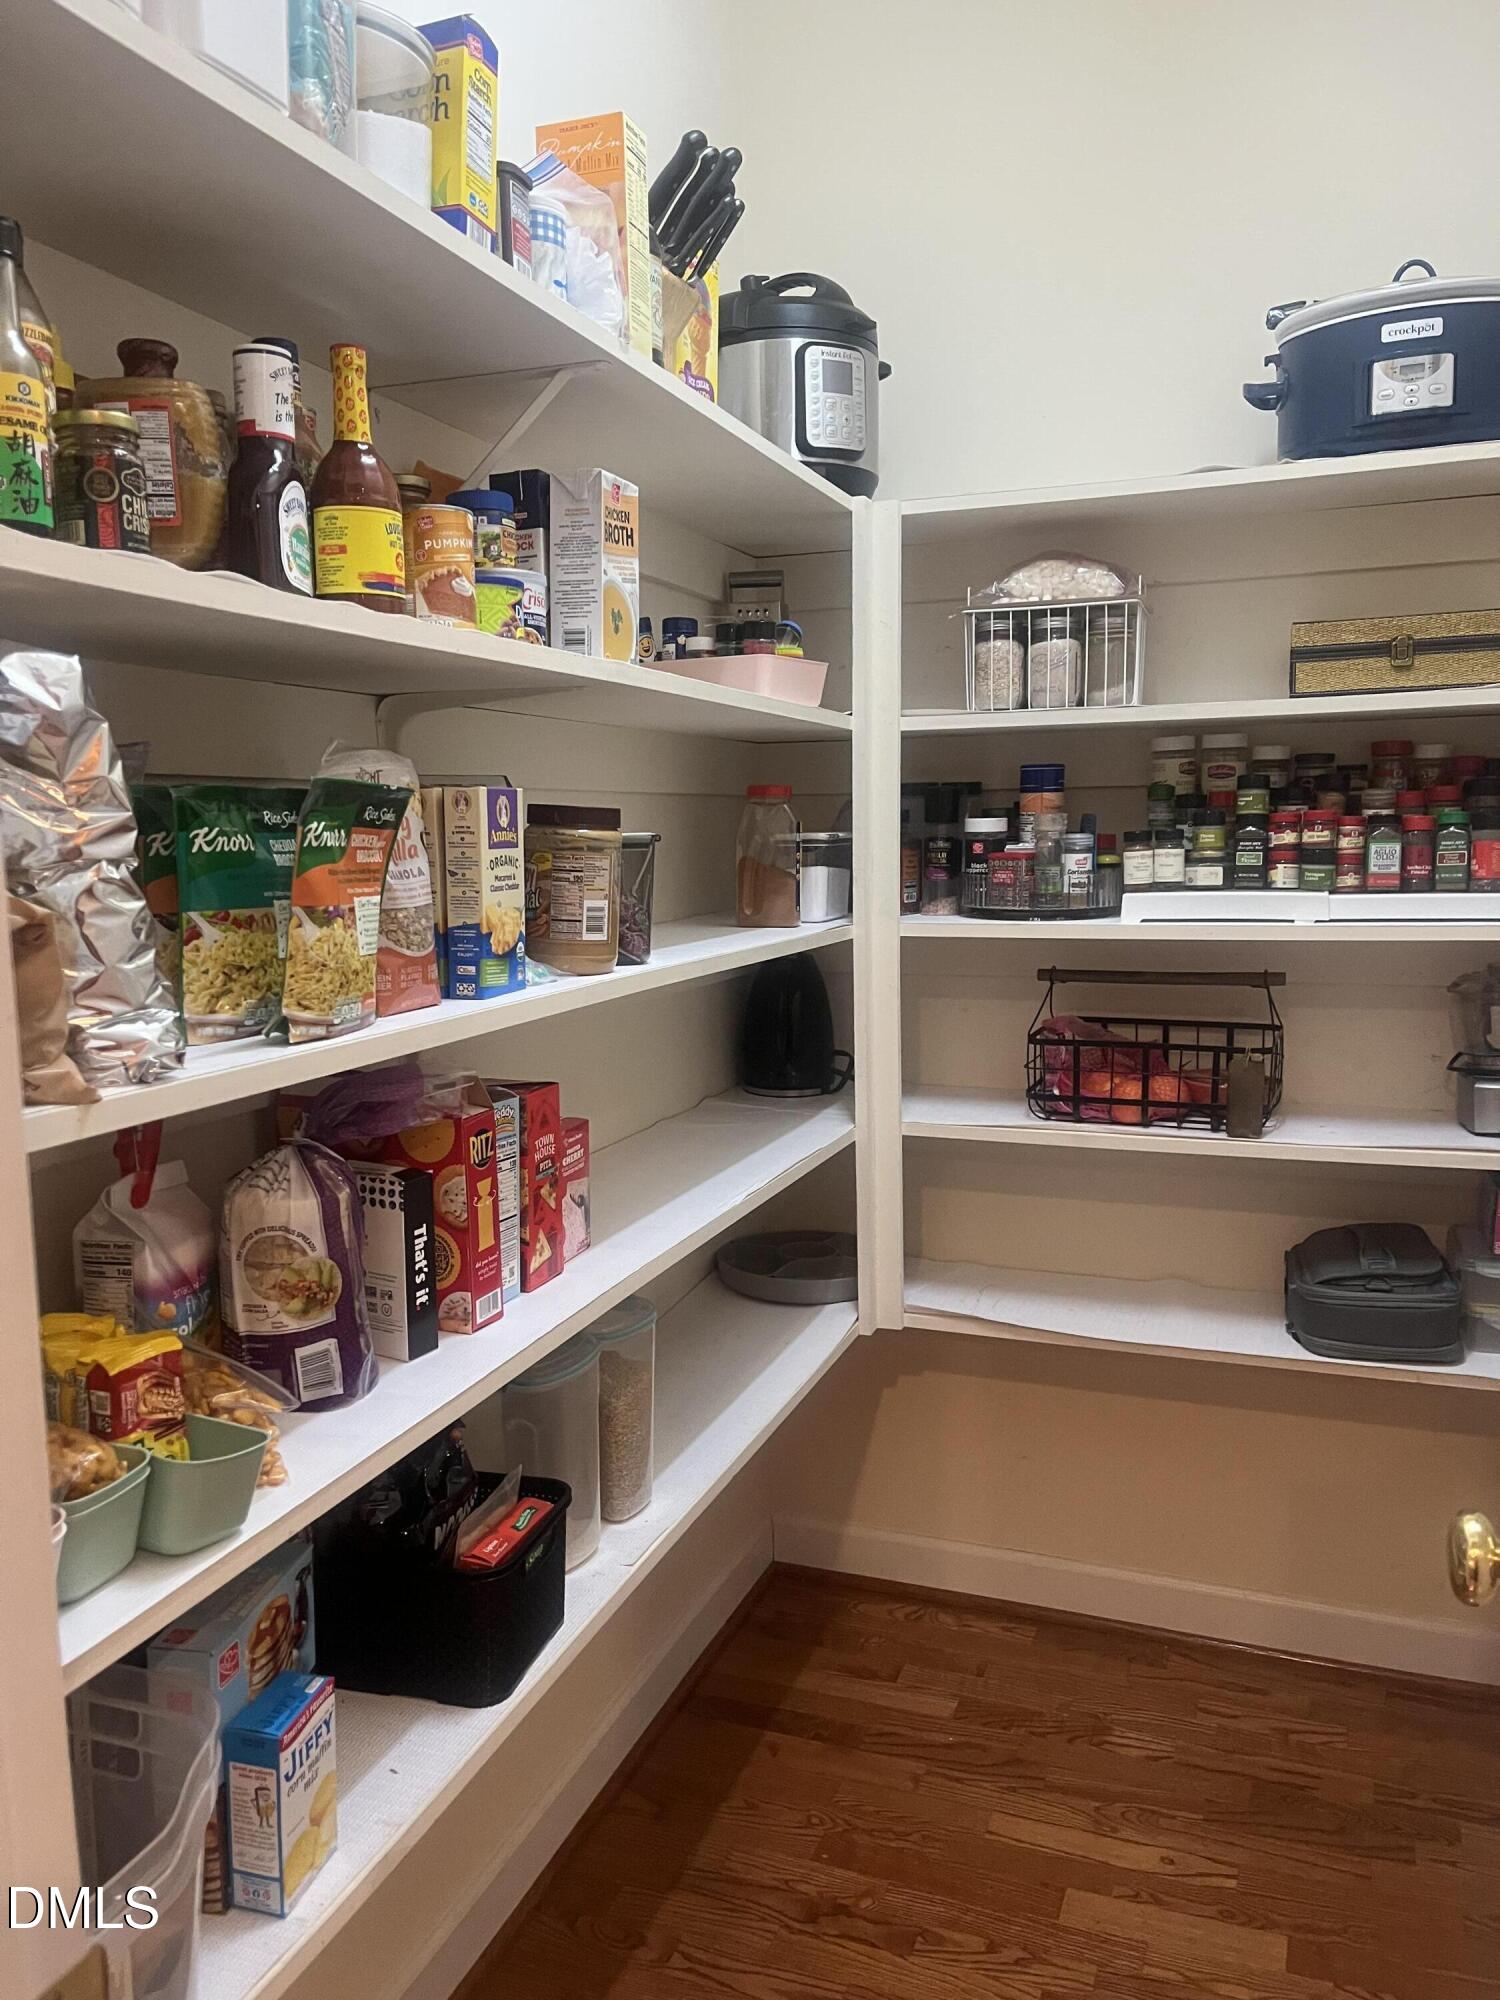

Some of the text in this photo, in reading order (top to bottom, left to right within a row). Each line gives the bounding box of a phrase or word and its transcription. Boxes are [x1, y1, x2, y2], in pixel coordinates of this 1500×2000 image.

[1388, 323, 1435, 338] crockpot
[275, 392, 289, 405] The
[0, 417, 38, 431] ESAME
[275, 409, 283, 422] is
[123, 514, 150, 536] CRIS
[604, 520, 634, 548] BROTH
[189, 826, 256, 855] Knorr
[303, 820, 348, 848] Knorr
[490, 828, 517, 844] Annie's
[489, 855, 519, 871] ORGANIC
[469, 1131, 494, 1165] RITZ
[534, 1133, 555, 1150] TOWN
[534, 1144, 557, 1163] HOUSE
[413, 1223, 429, 1284] That's
[283, 1710, 334, 1783] JIFFY
